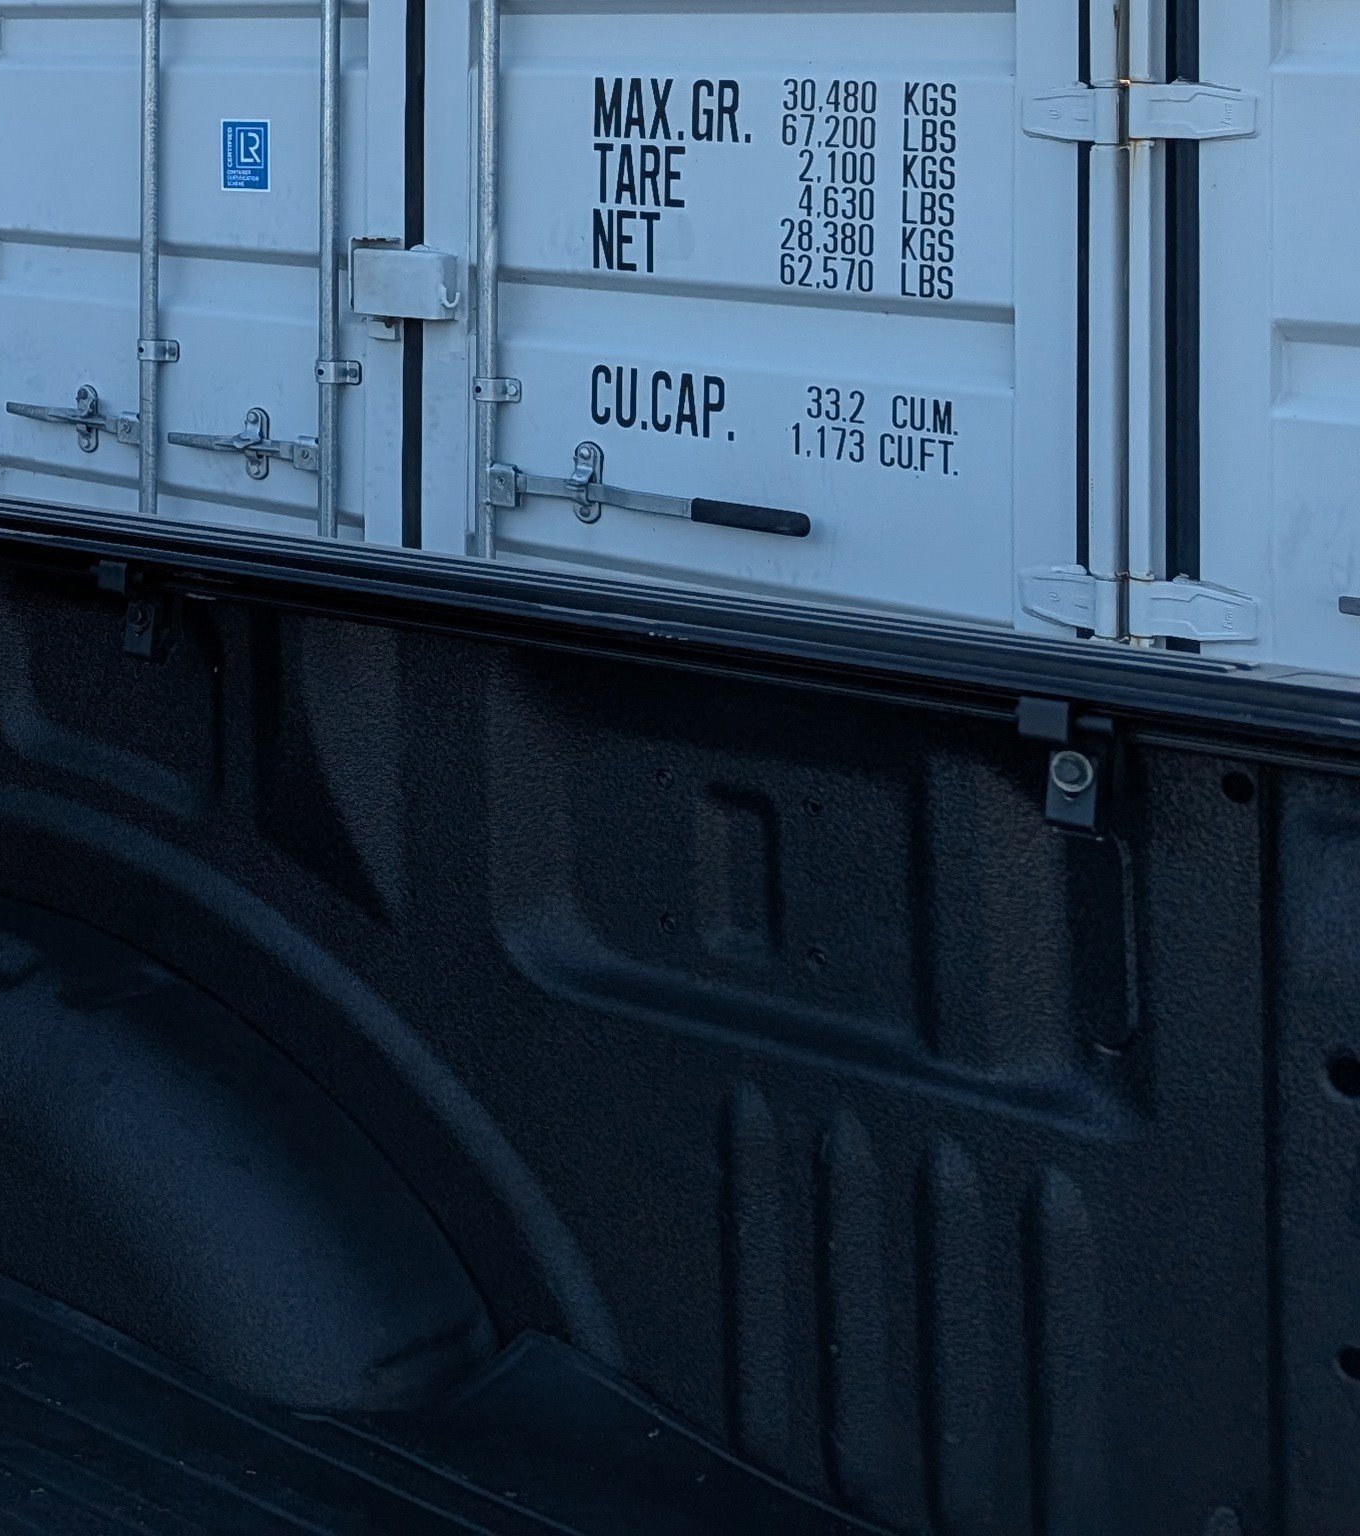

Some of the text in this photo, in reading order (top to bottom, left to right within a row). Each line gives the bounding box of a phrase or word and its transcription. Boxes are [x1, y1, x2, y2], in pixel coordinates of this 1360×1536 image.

[783, 78, 957, 117] 30,480 KGS
[240, 131, 261, 163] LR
[781, 113, 957, 154] 67,200 LBS
[593, 143, 686, 208] TARE
[798, 149, 956, 190] 2,100 KGS
[798, 184, 955, 227] 4,630 LBS
[592, 208, 661, 273] NET
[780, 218, 954, 263] 28,380 KGS
[780, 253, 954, 300] 62,570 LBS
[807, 385, 959, 436] 33.2 CU.M.
[791, 422, 958, 476] 1,173 CU.FT.
